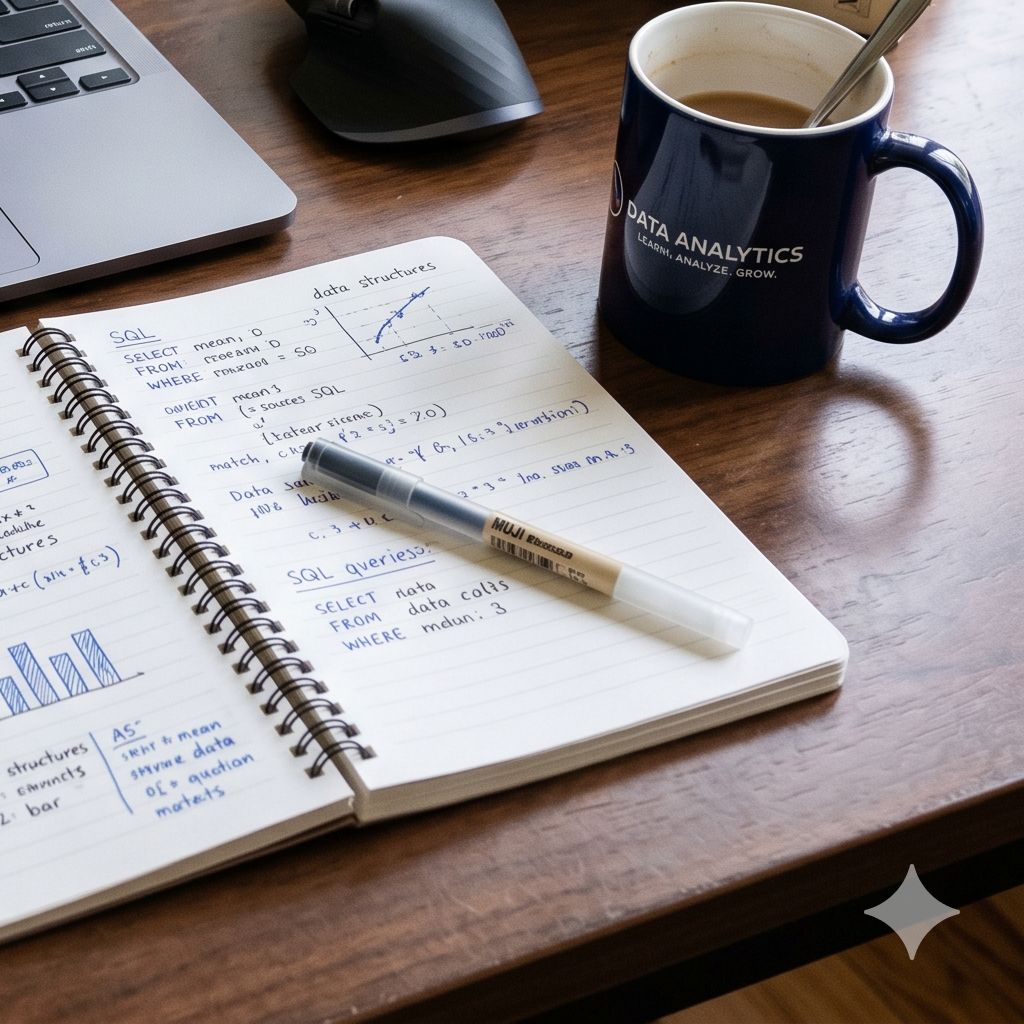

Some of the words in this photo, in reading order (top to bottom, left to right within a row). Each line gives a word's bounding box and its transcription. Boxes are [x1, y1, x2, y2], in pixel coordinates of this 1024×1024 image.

[627, 199, 670, 243] DATA
[674, 231, 804, 264] ANALYTICS
[675, 253, 732, 276] ANALYZE.
[736, 267, 777, 279] GROW.
[313, 284, 350, 301] data
[359, 261, 437, 289] structures
[110, 327, 156, 344] SQL
[124, 346, 178, 364] SELECT
[135, 360, 183, 376] FROM
[311, 384, 346, 400] SQL
[174, 413, 223, 430] FROM
[229, 485, 273, 503] Data
[491, 517, 527, 541] MUJI
[287, 565, 334, 585] SQL
[315, 591, 377, 615] SELECT
[329, 612, 382, 633] FROM
[408, 597, 451, 617] data
[342, 627, 407, 652] WHERE
[177, 720, 223, 743] mean
[193, 735, 236, 760] data
[6, 742, 89, 779] structures
[26, 797, 61, 818] bar
